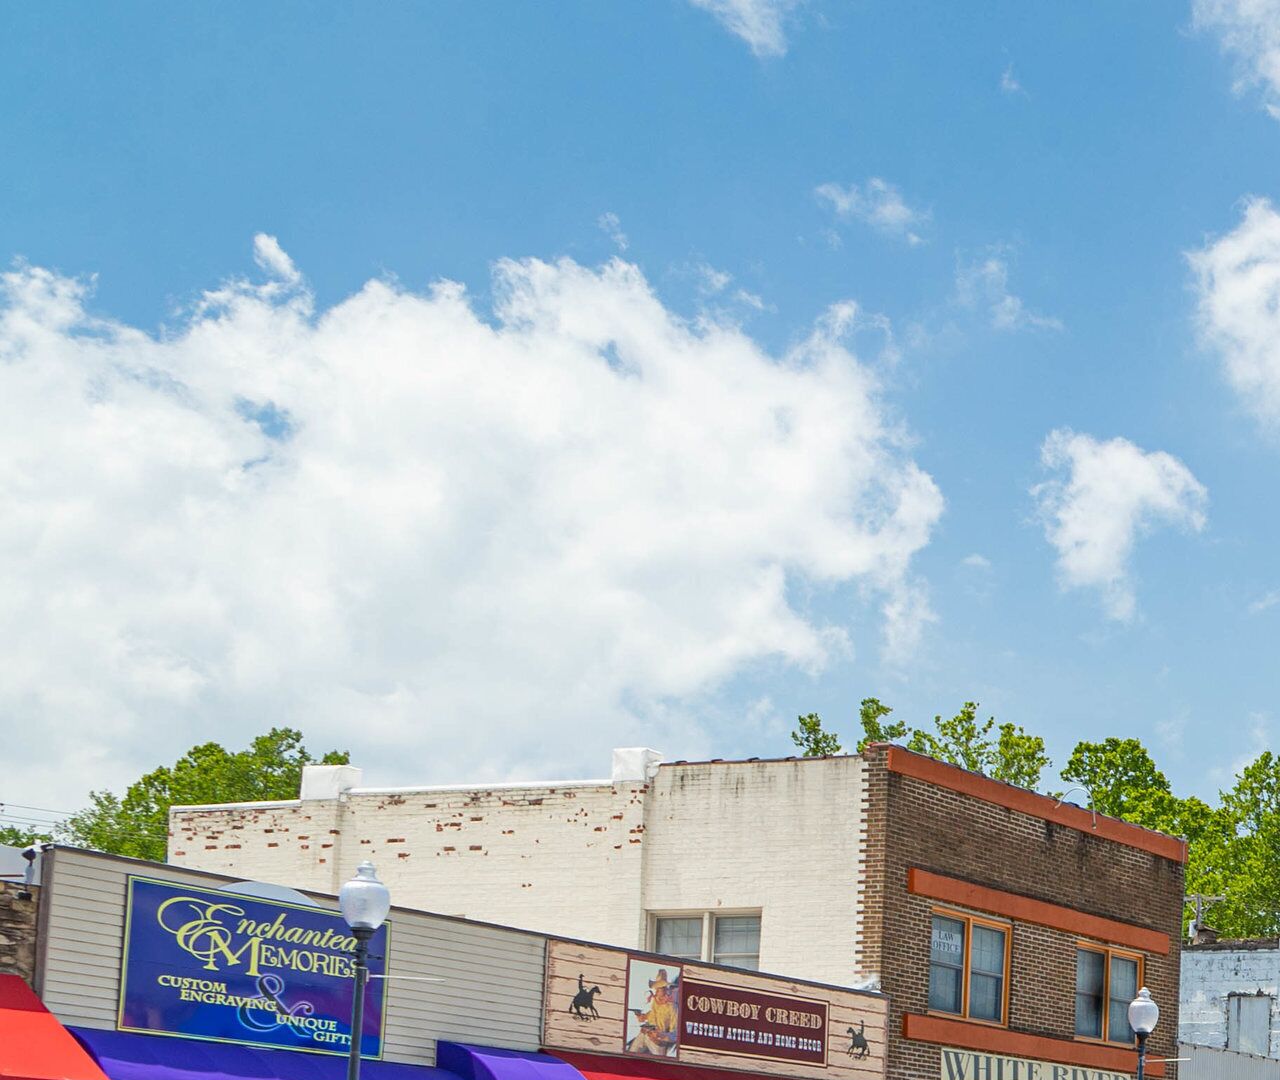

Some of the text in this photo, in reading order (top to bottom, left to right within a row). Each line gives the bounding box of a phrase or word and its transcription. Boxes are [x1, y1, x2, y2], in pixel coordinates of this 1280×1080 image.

[938, 930, 954, 941] LAW
[932, 940, 960, 953] OFFICE
[157, 974, 228, 994] CUSTOM
[179, 989, 277, 1012] ENGRAVING
[275, 1013, 338, 1032] UNIQUE
[686, 994, 823, 1031] COWBOY CREED
[685, 1020, 822, 1053] WESTERN ATTIRE AND HOME DECOR
